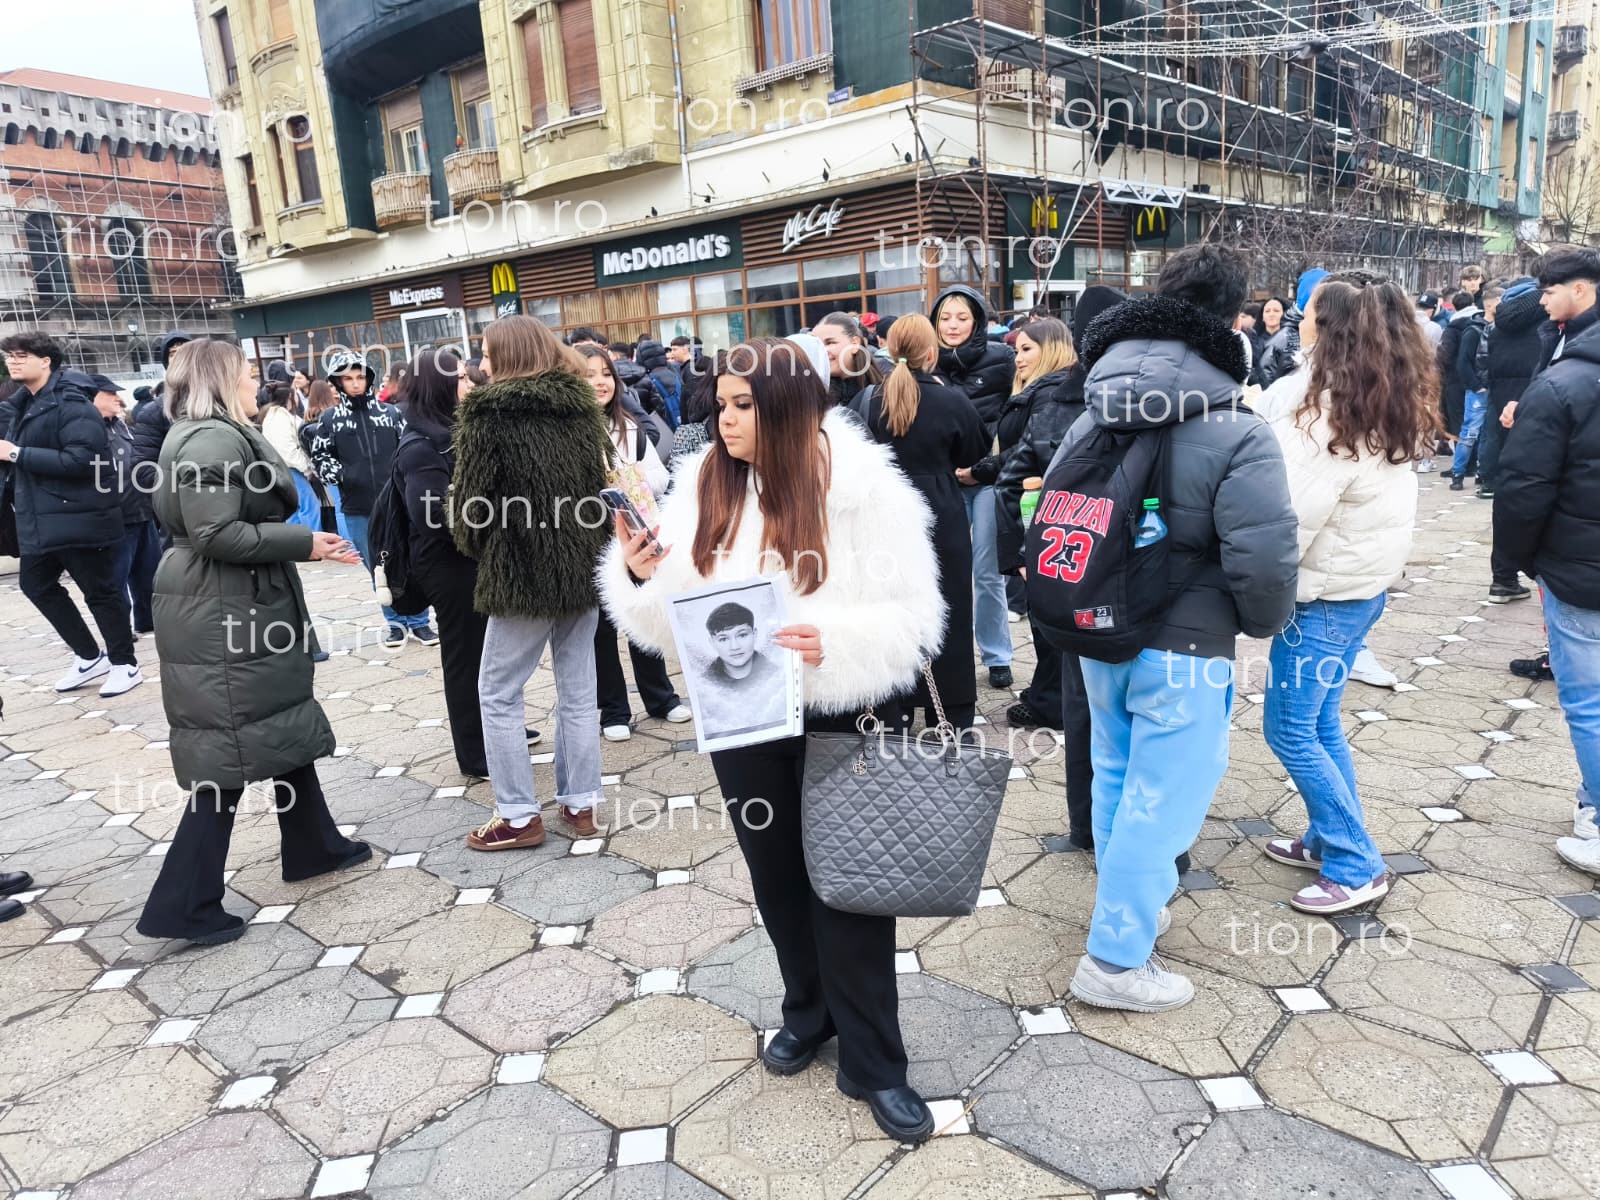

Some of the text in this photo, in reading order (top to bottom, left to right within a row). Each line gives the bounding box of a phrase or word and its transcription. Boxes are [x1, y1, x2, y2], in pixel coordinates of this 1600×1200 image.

[603, 233, 731, 276] McDonald's
[389, 286, 444, 307] McExpress
[1038, 526, 1094, 584] 23
